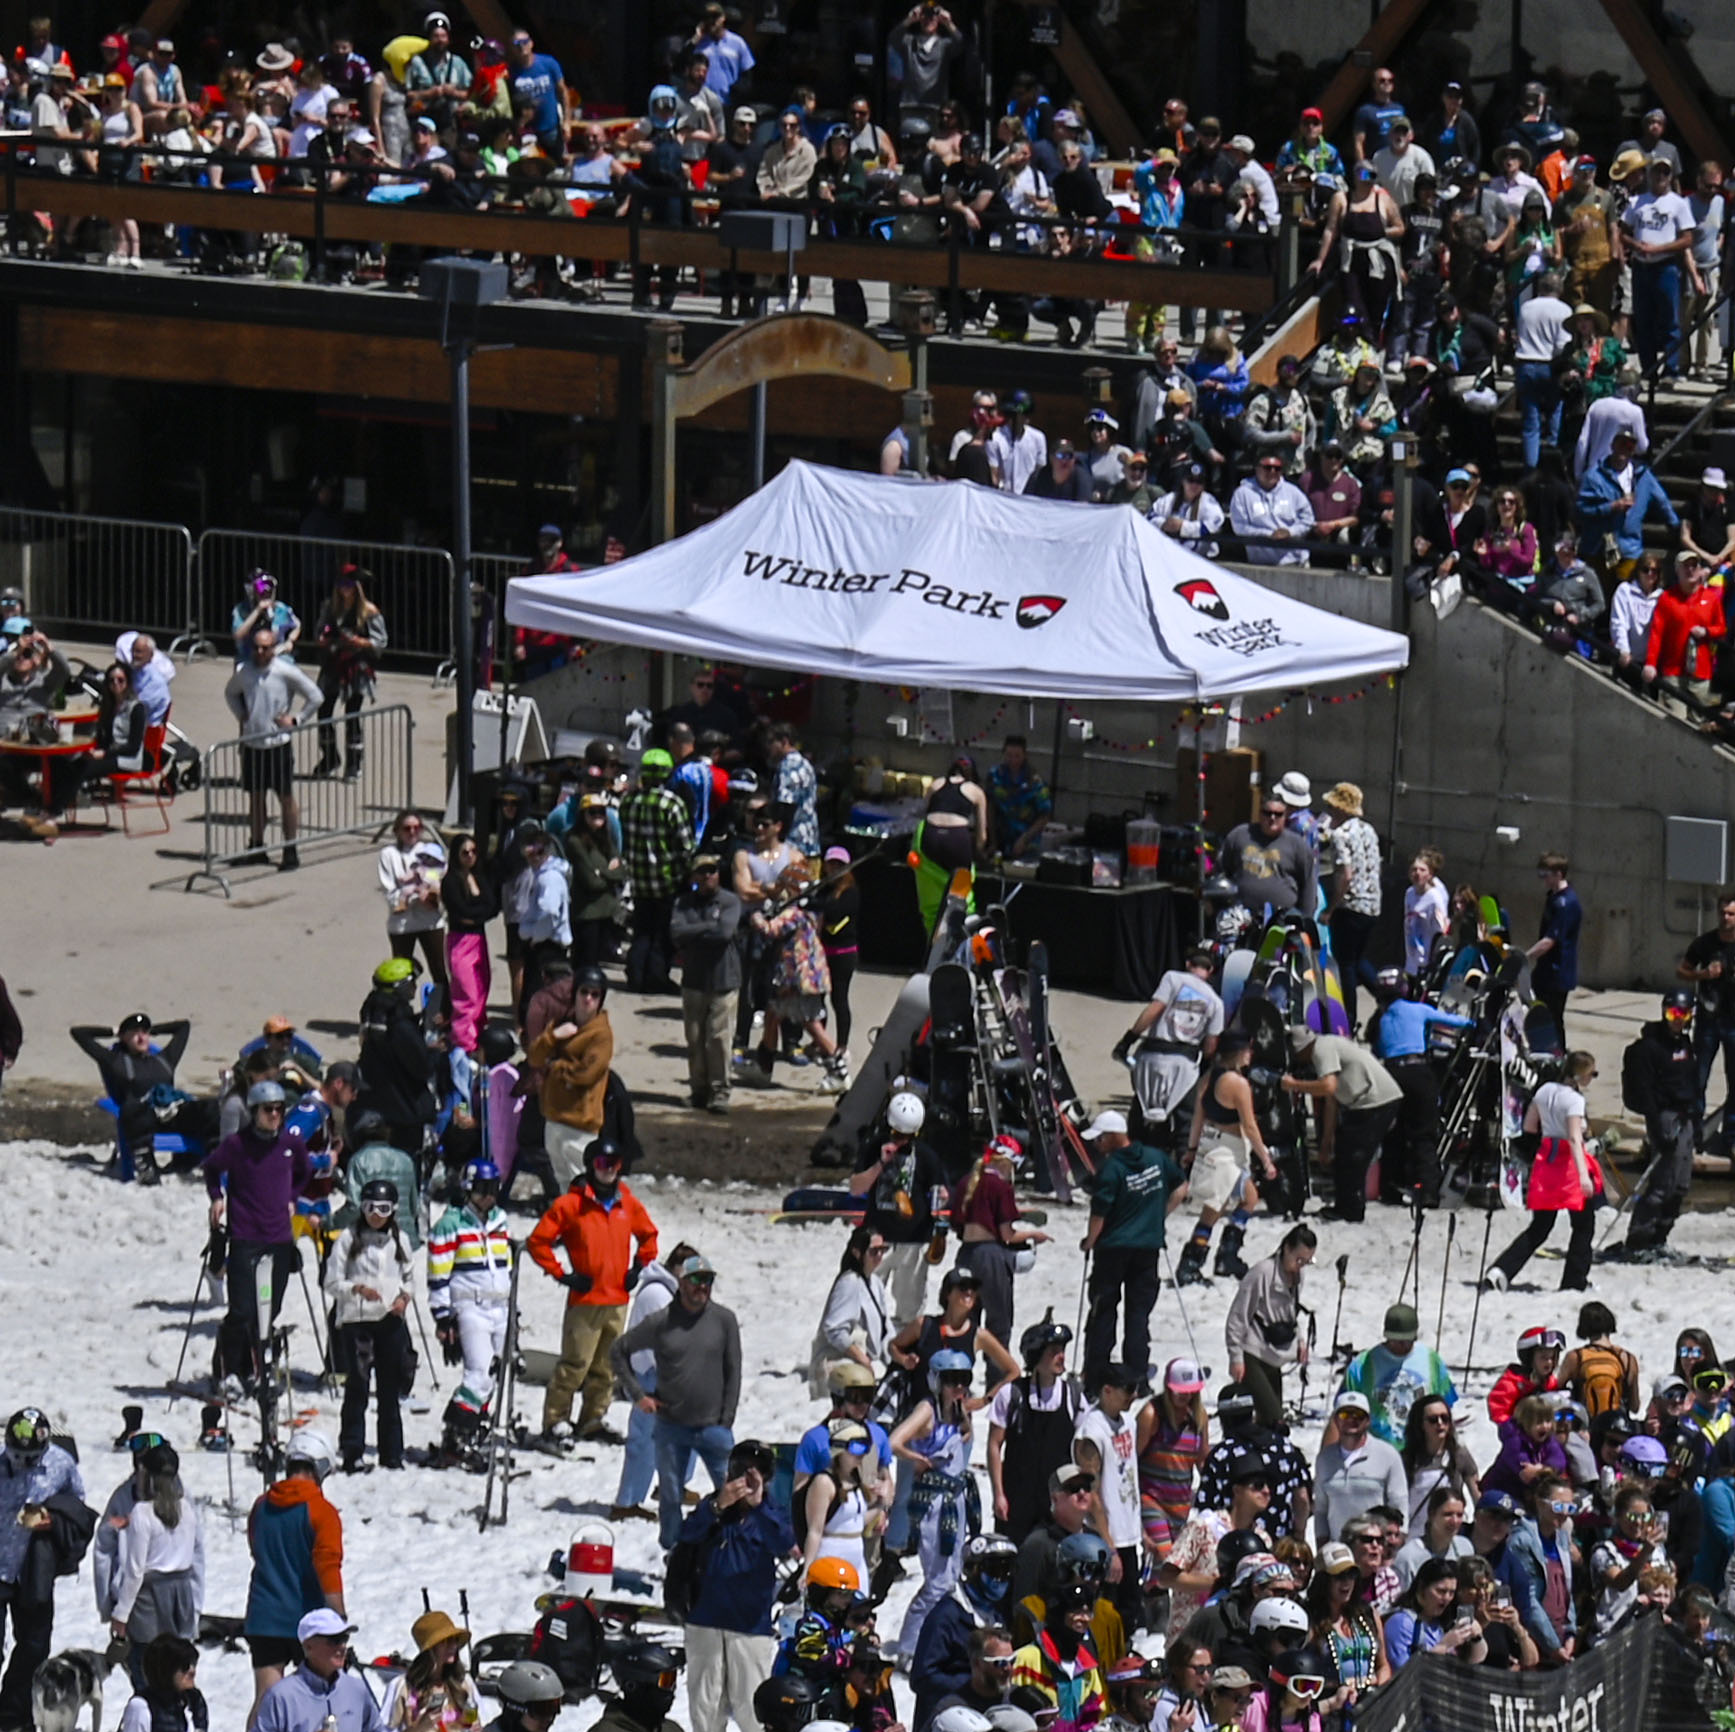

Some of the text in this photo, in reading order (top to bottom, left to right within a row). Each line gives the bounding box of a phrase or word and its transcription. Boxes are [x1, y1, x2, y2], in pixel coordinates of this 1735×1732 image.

[742, 550, 1010, 620] Winter Park
[1194, 615, 1282, 649] Winter
